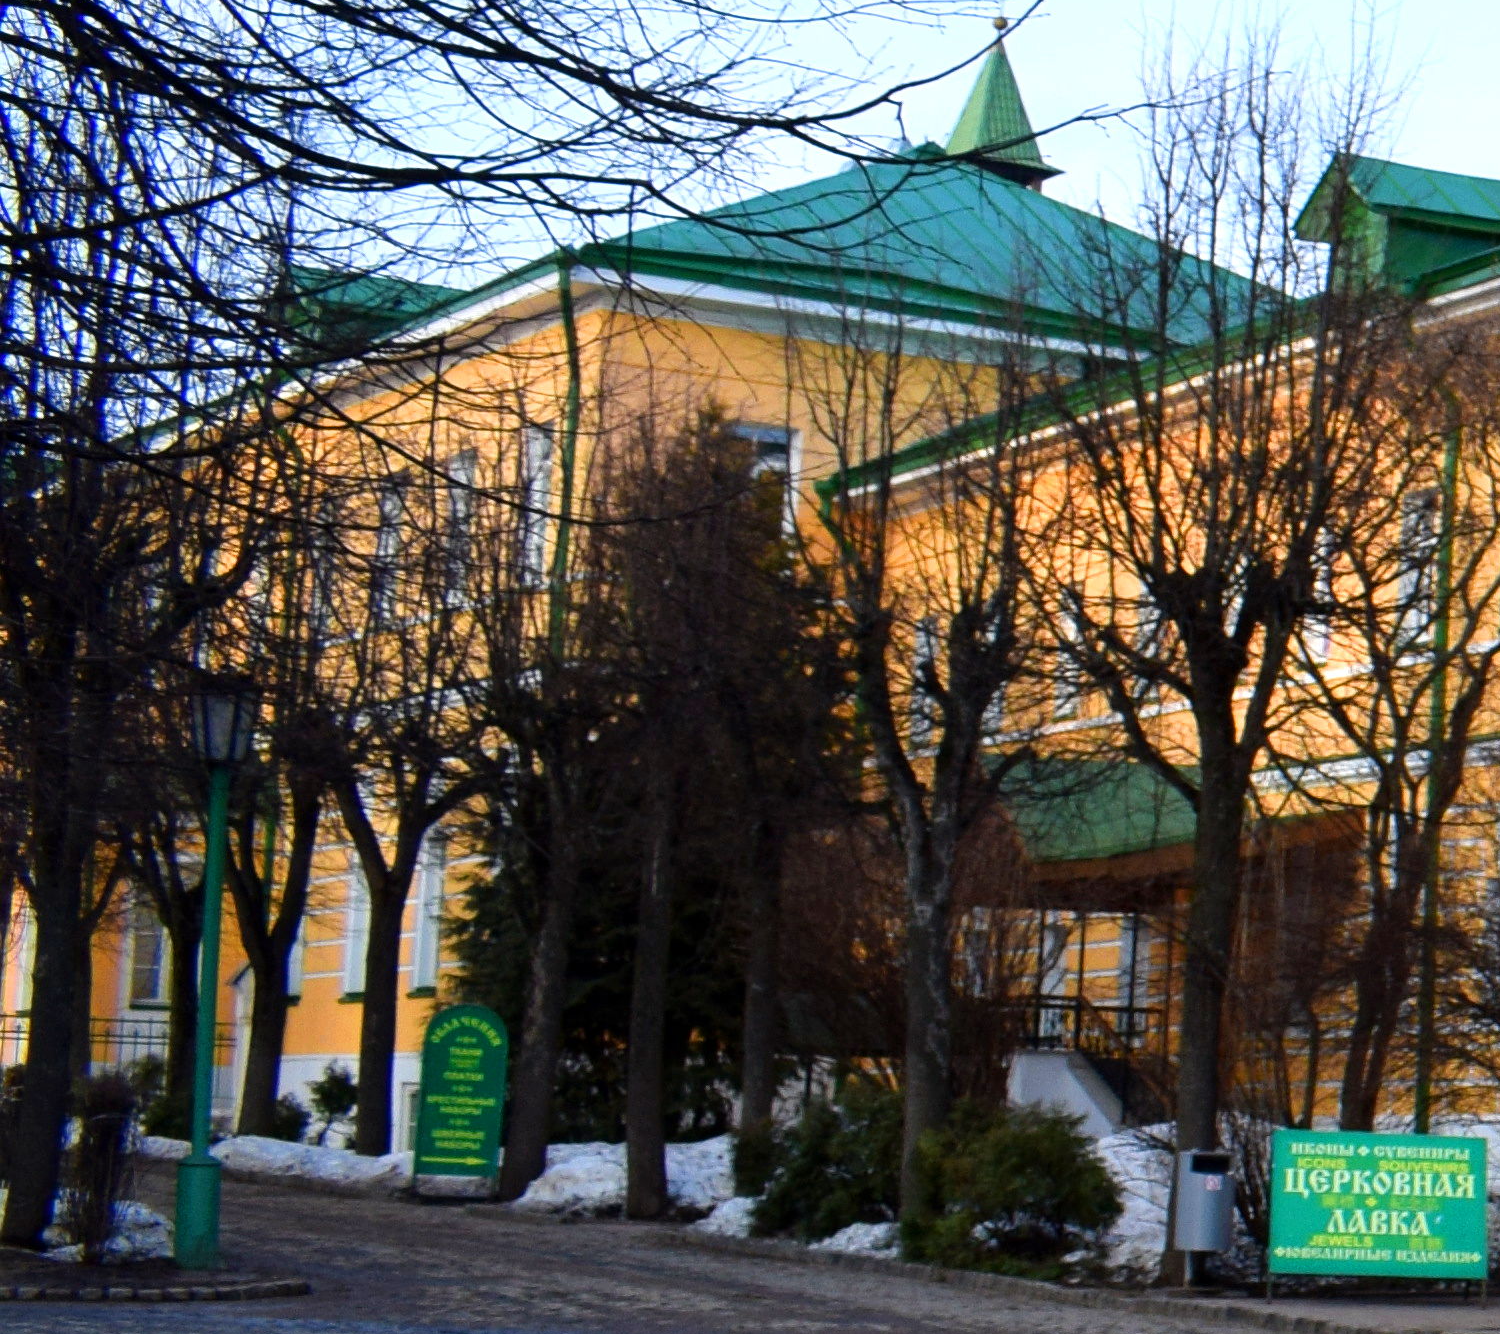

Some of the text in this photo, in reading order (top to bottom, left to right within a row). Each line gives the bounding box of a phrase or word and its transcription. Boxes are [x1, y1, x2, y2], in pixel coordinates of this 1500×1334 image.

[1290, 1142, 1470, 1161] ИКОНЫ СУВЕНИРЫ
[1297, 1157, 1470, 1173] ICONS SOUVENIRS
[1283, 1167, 1476, 1199] ЦЕРКОВНАЯ
[1326, 1209, 1431, 1236] ЛАВКА
[1308, 1235, 1374, 1247] JEWELS
